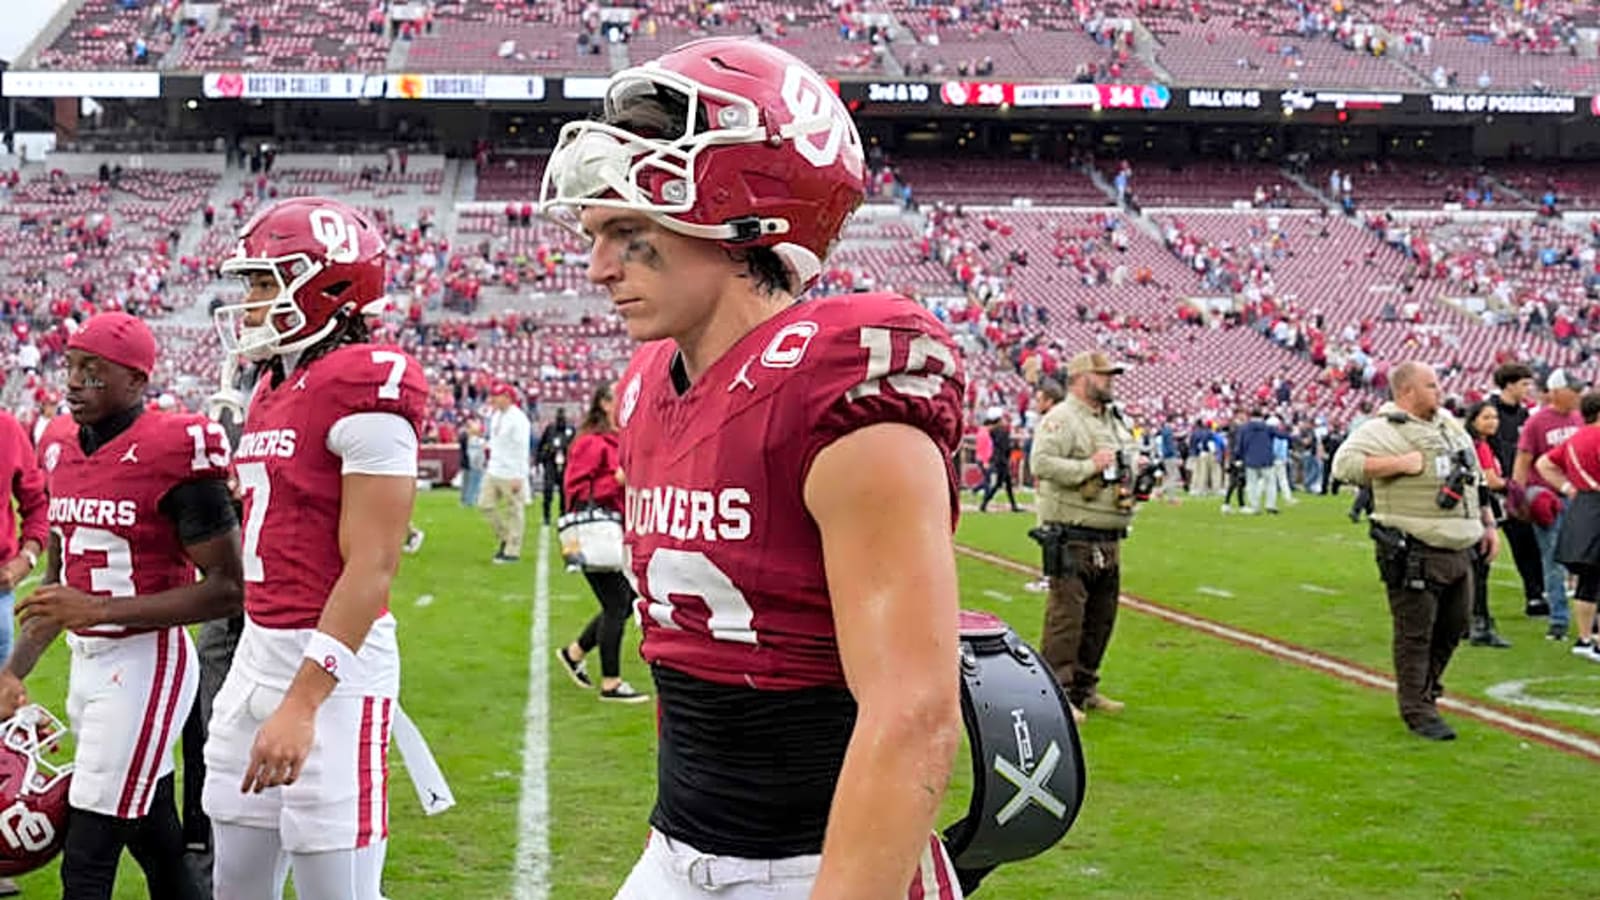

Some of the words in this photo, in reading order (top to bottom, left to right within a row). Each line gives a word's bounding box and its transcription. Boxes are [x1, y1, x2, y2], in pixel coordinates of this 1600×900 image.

[868, 84, 896, 101] 3rd
[909, 84, 929, 101] 10
[1109, 86, 1135, 106] 34
[1189, 90, 1221, 107] BALL
[1222, 91, 1244, 107] ON
[1431, 95, 1465, 111] TIME
[1466, 95, 1487, 111] OF
[1488, 96, 1575, 113] POSSESSION
[309, 209, 360, 264] OU
[762, 322, 818, 368] C
[371, 351, 408, 400] 7
[187, 423, 231, 471] 13
[236, 462, 271, 582] 7
